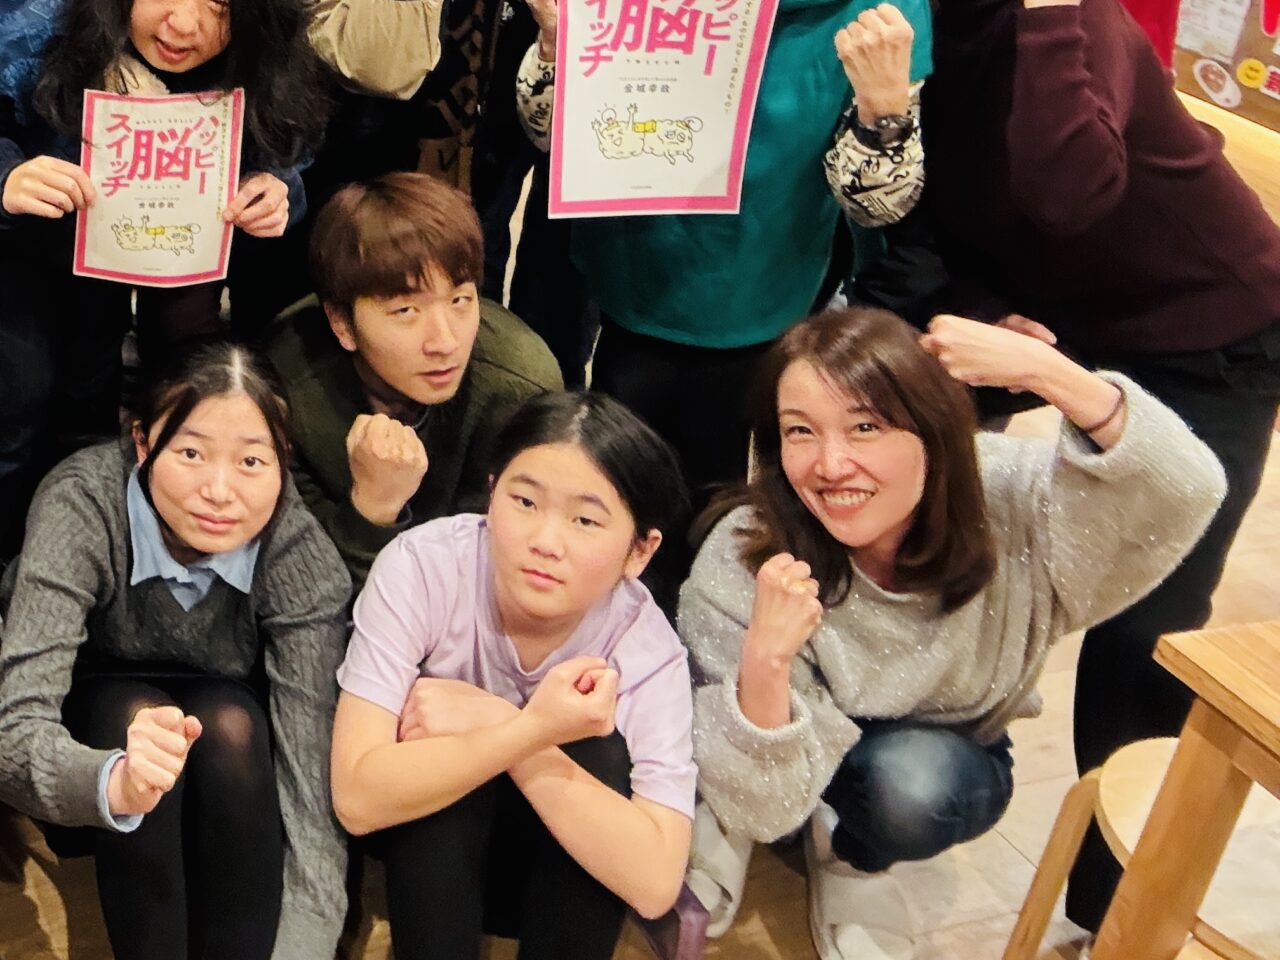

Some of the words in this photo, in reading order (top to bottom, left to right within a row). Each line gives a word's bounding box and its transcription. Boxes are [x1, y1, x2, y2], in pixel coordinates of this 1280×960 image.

[101, 113, 132, 197] スイッチ
[127, 127, 193, 181] 脳
[193, 115, 220, 194] ハッピー
